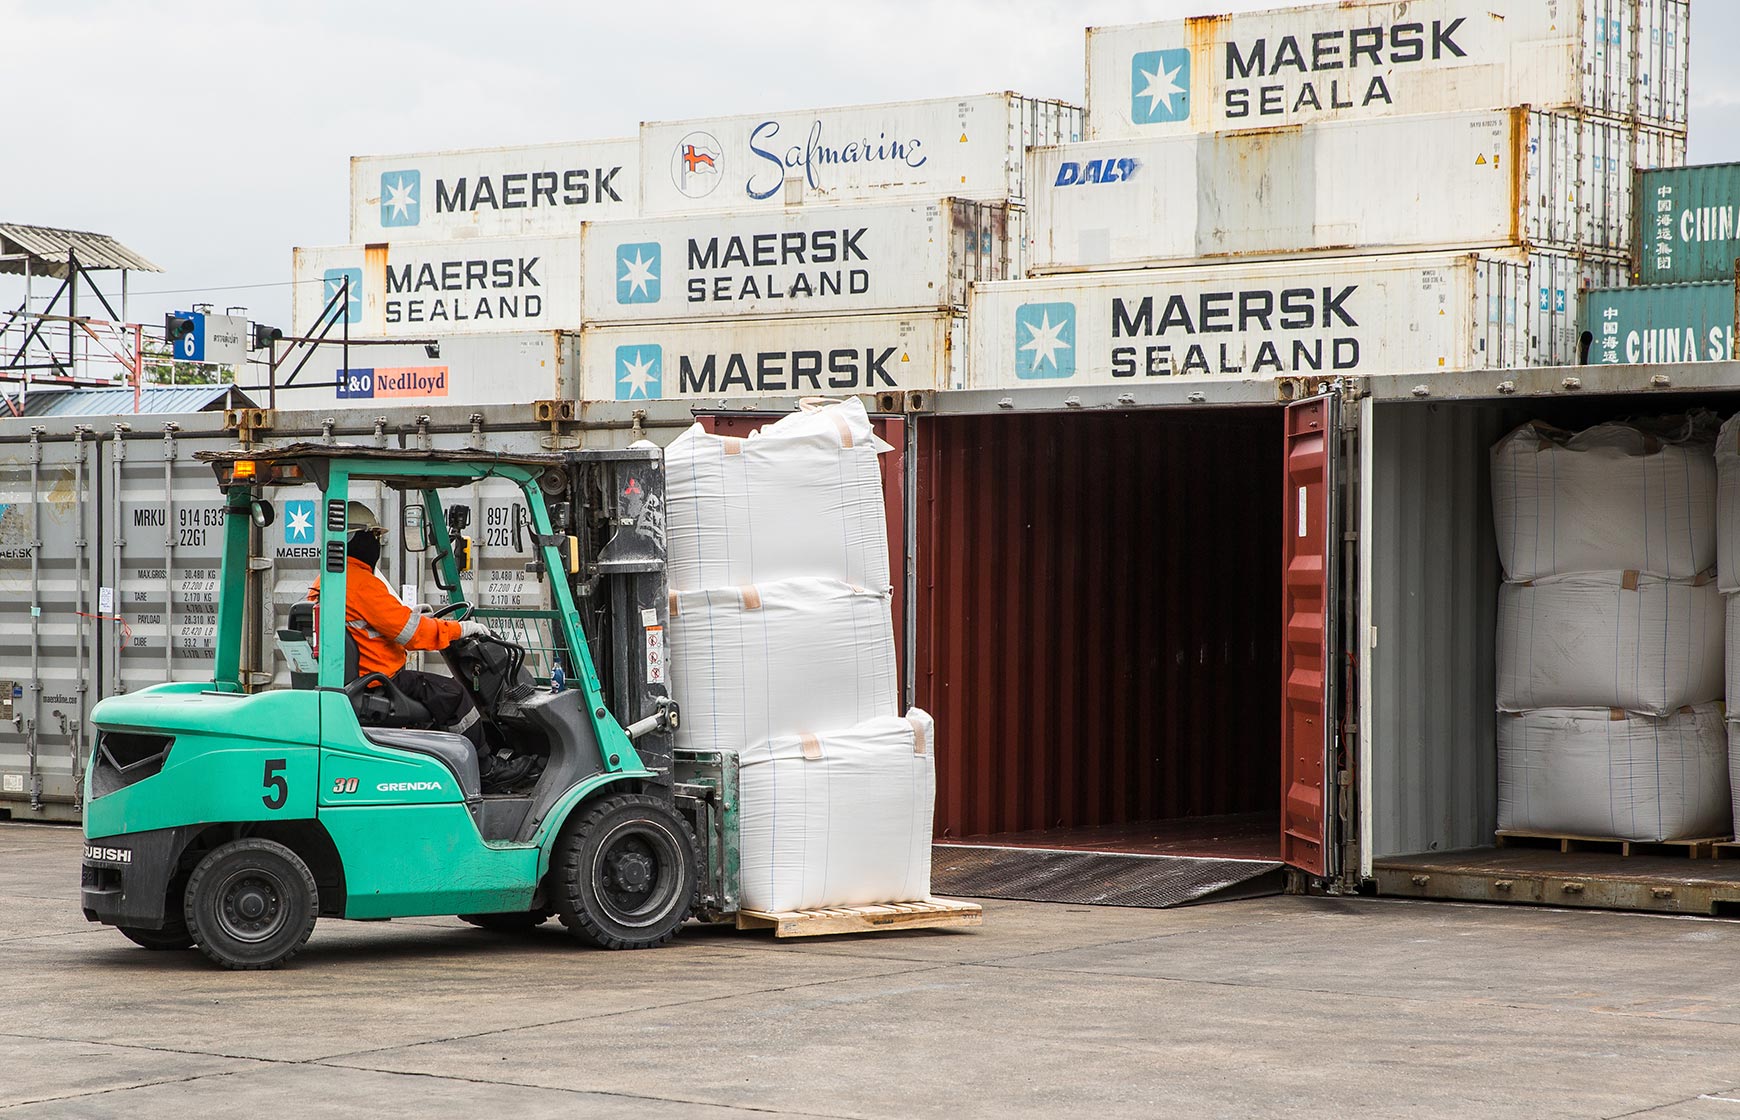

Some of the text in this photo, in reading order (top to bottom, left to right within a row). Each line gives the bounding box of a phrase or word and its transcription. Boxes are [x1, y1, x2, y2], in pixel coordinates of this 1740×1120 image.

[1226, 17, 1467, 80] MAERSK
[1225, 76, 1393, 118] SEALA
[746, 120, 927, 200] Safmarine
[436, 166, 623, 213] MAERSK
[1680, 205, 1740, 243] CHIN
[688, 227, 869, 270] MAERSK
[386, 257, 541, 294] MAERSK
[688, 269, 869, 302] SEALAND
[386, 295, 542, 323] SEALAND
[1112, 285, 1359, 338] MAERSK
[184, 332, 195, 357] 6
[1626, 327, 1698, 363] CHINA
[679, 346, 898, 394] MAERSK
[1111, 337, 1360, 378] SEALAND
[378, 372, 445, 393] Nedlloyd
[134, 509, 224, 526] MRKU 914 633
[487, 507, 509, 525] 897
[180, 529, 206, 546] 22G1
[276, 548, 321, 558] MAERSK
[205, 582, 214, 591] LB
[208, 570, 216, 579] KG
[492, 571, 525, 581] 30.480 KG
[204, 593, 212, 602] KG
[488, 584, 523, 592] 67.200 LB
[491, 595, 509, 605] 2.170
[512, 595, 521, 605] KG
[138, 615, 160, 624] PAYLOAD
[208, 616, 216, 625] KG
[134, 637, 147, 646] CUBE
[261, 758, 288, 810] 5
[332, 778, 359, 794] 30
